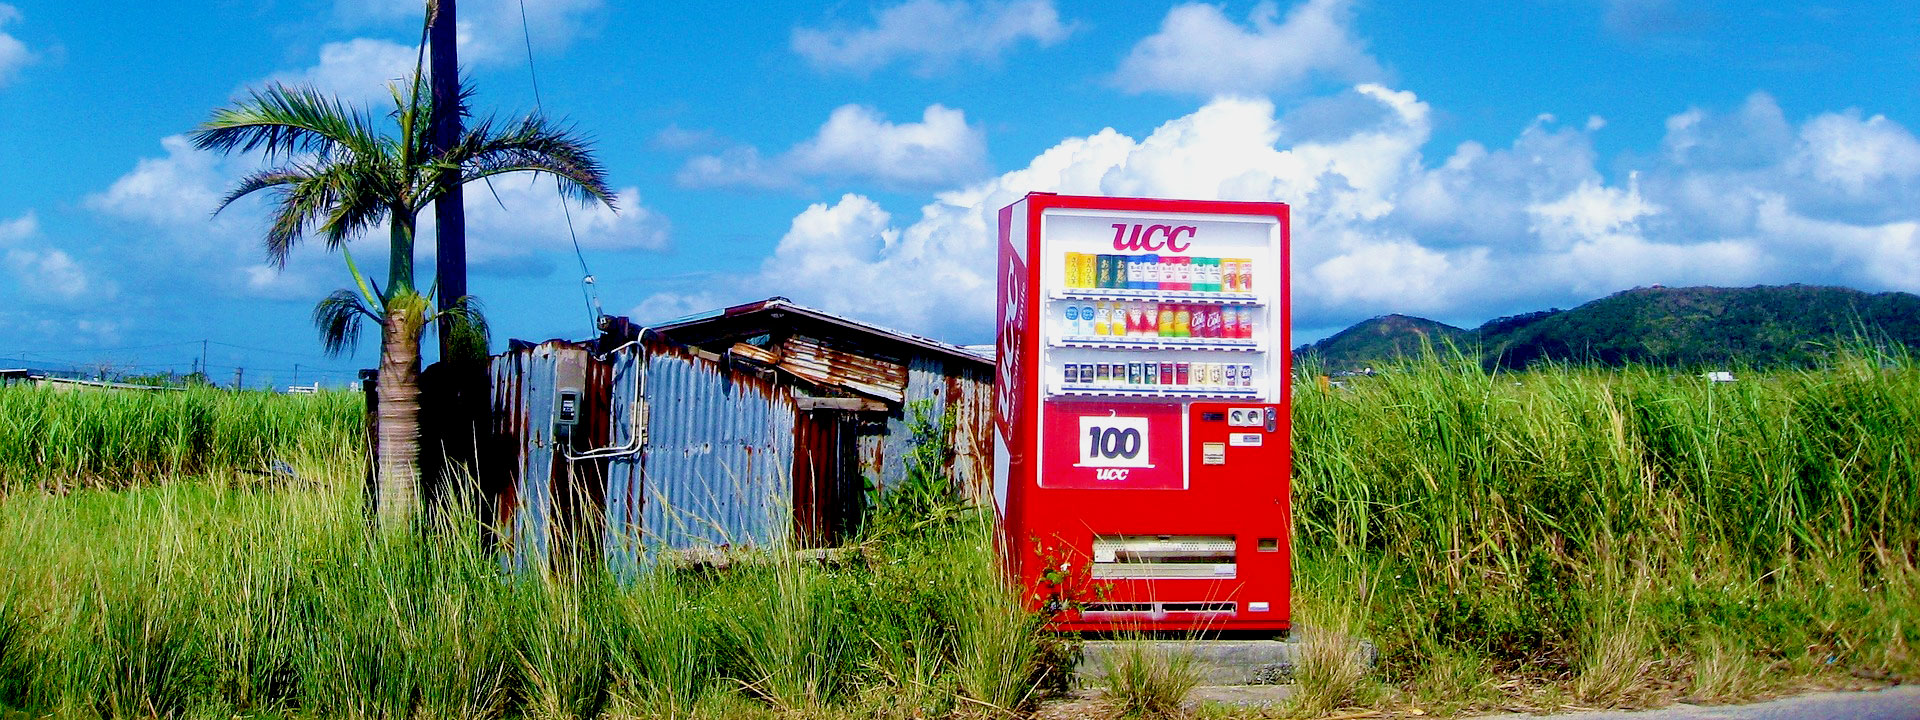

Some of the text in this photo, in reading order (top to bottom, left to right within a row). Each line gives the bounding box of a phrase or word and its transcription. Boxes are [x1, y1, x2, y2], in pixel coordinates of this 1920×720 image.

[1007, 393, 1016, 441] Good
[1012, 335, 1020, 390] Coffee
[1090, 426, 1141, 459] 100
